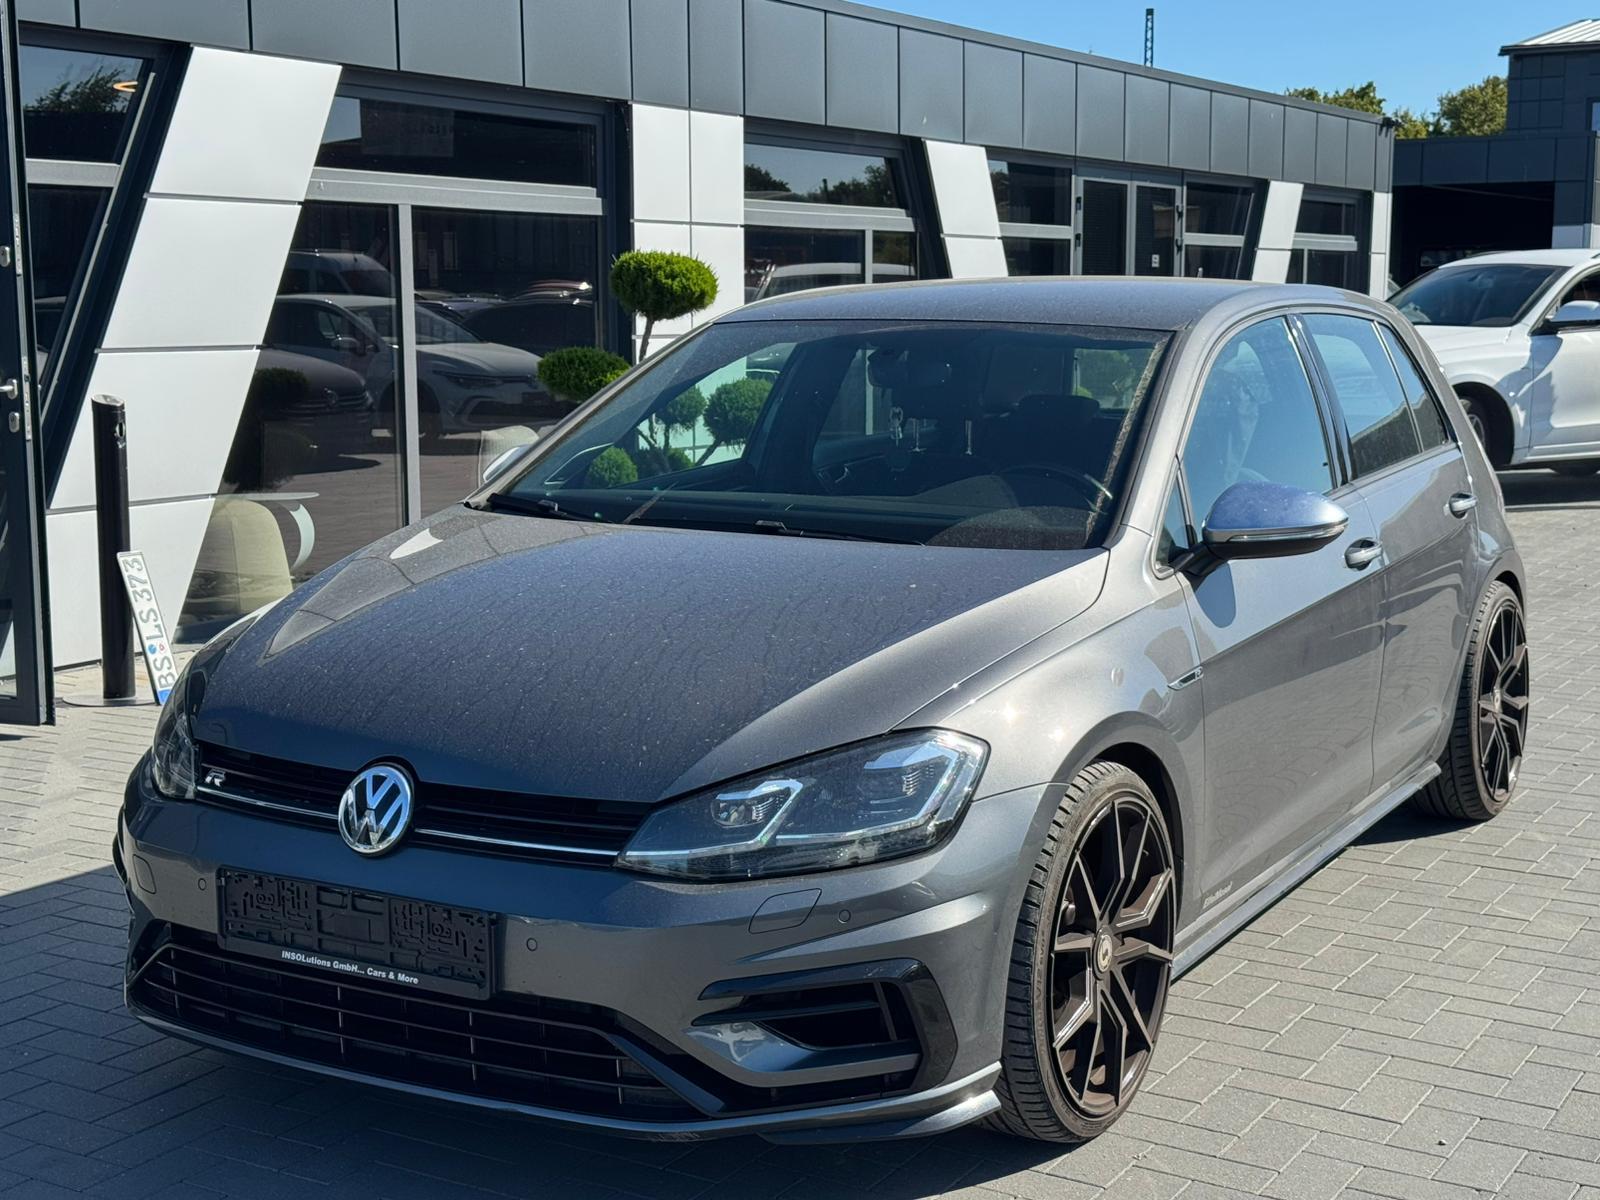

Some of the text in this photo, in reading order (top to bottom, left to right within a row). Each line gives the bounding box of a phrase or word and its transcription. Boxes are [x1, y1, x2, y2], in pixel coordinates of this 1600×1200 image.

[122, 557, 176, 689] BS LS 373
[205, 768, 226, 787] R
[341, 765, 410, 851] VW
[281, 950, 331, 969] INSOLutions
[366, 967, 387, 979] Cars
[388, 971, 395, 980] &
[397, 972, 419, 985] More
